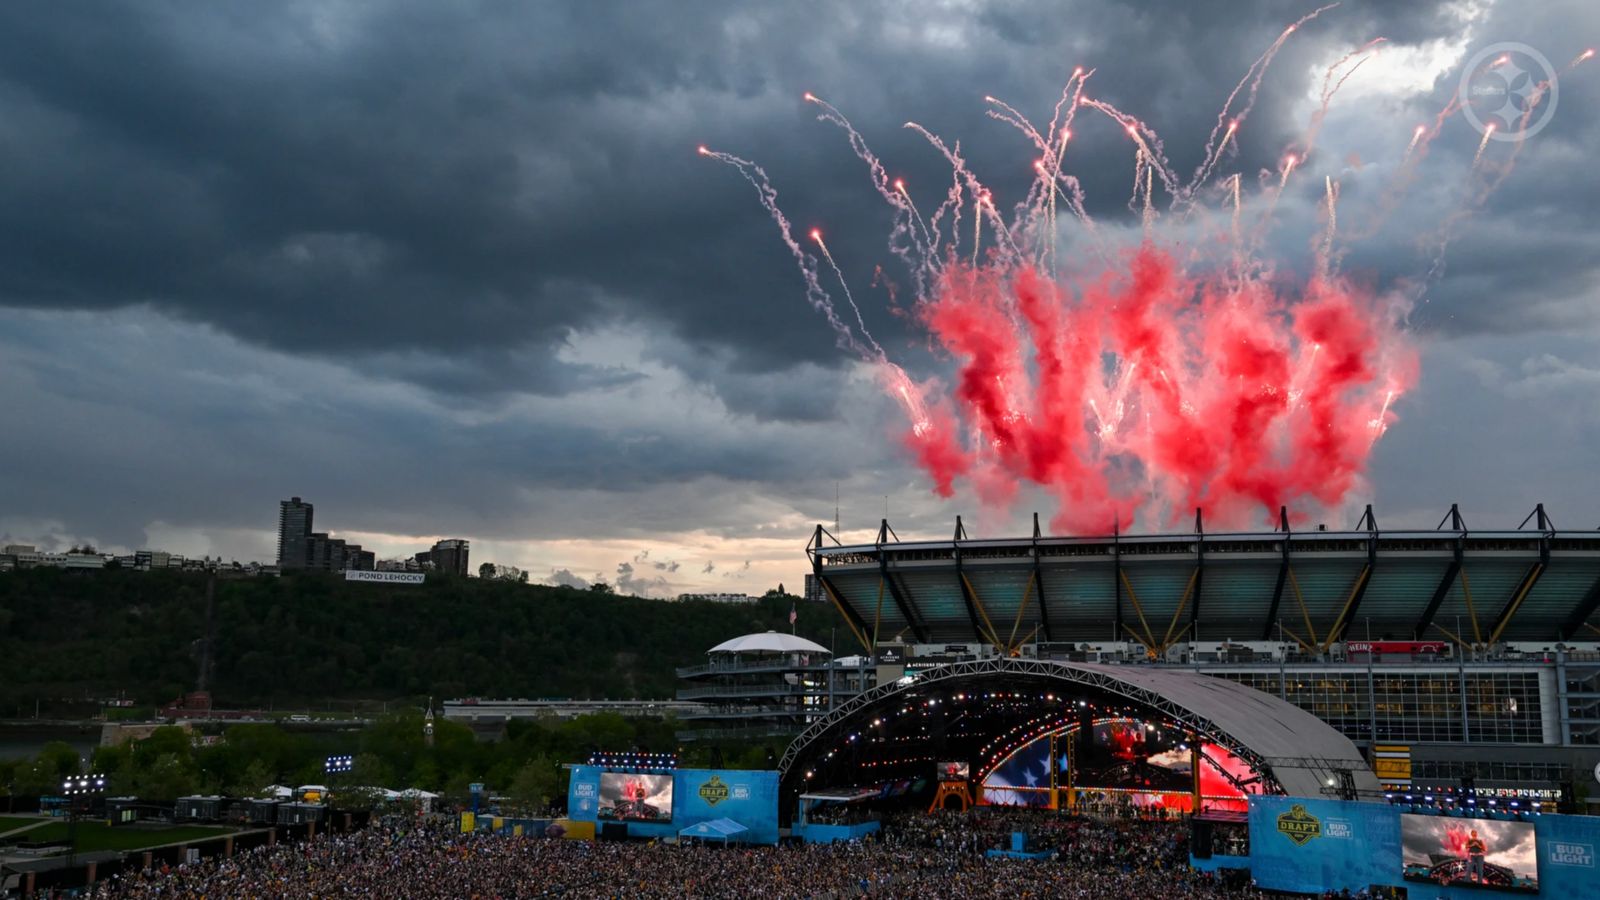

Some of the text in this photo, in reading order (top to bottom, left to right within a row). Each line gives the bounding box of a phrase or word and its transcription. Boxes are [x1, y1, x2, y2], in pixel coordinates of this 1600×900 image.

[358, 572, 383, 580] POND
[1348, 644, 1373, 652] HEINZ
[1280, 822, 1317, 832] DRAFT
[1329, 823, 1348, 831] BUD
[1326, 829, 1351, 837] LIGHT
[1556, 844, 1585, 855] BUD
[1551, 852, 1591, 865] LIGHT
